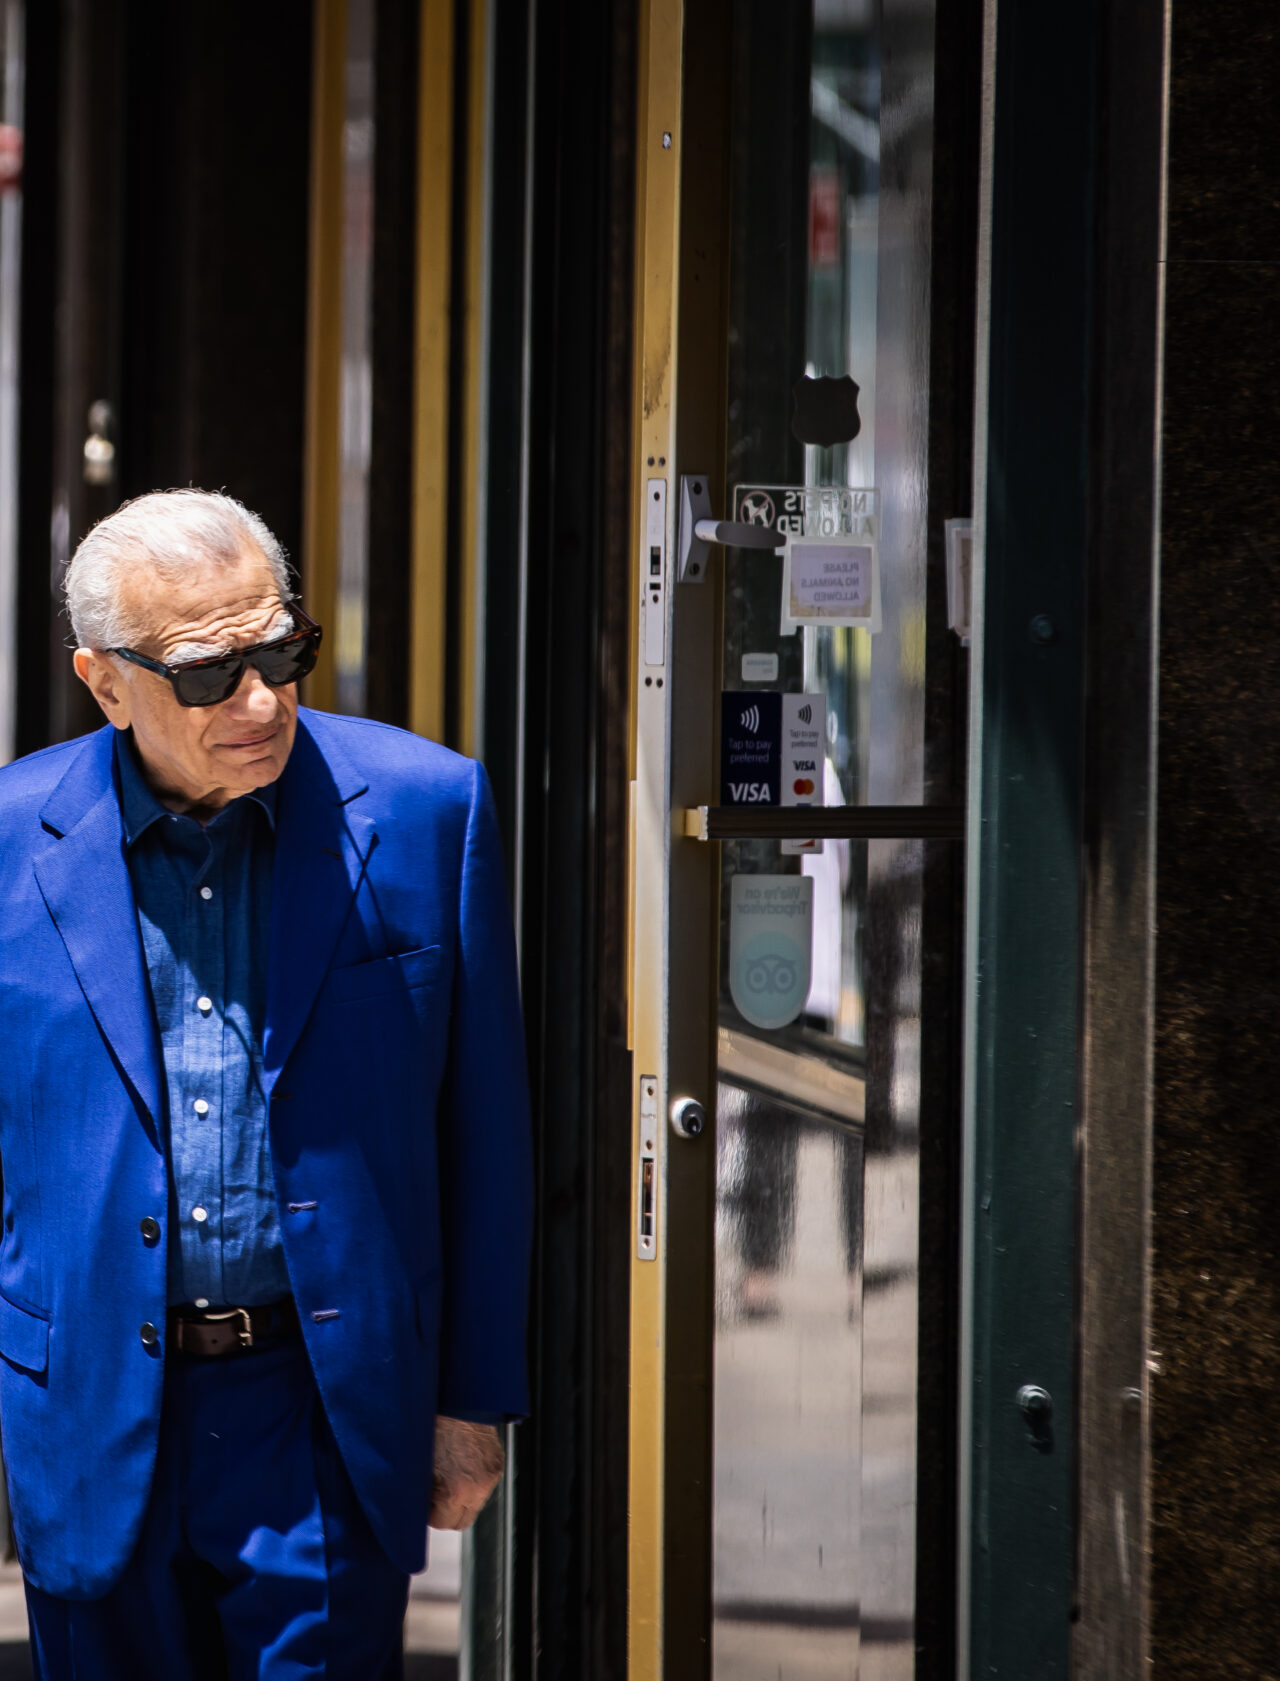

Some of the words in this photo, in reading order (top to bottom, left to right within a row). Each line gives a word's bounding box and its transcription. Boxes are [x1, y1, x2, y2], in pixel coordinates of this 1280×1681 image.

[789, 729, 800, 738] Tap
[728, 738, 743, 751] Tap
[745, 739, 755, 749] to
[756, 740, 772, 751] pay
[791, 740, 818, 749] preferred
[730, 752, 770, 764] preferred
[793, 760, 816, 771] VISA
[728, 783, 771, 802] VISA
